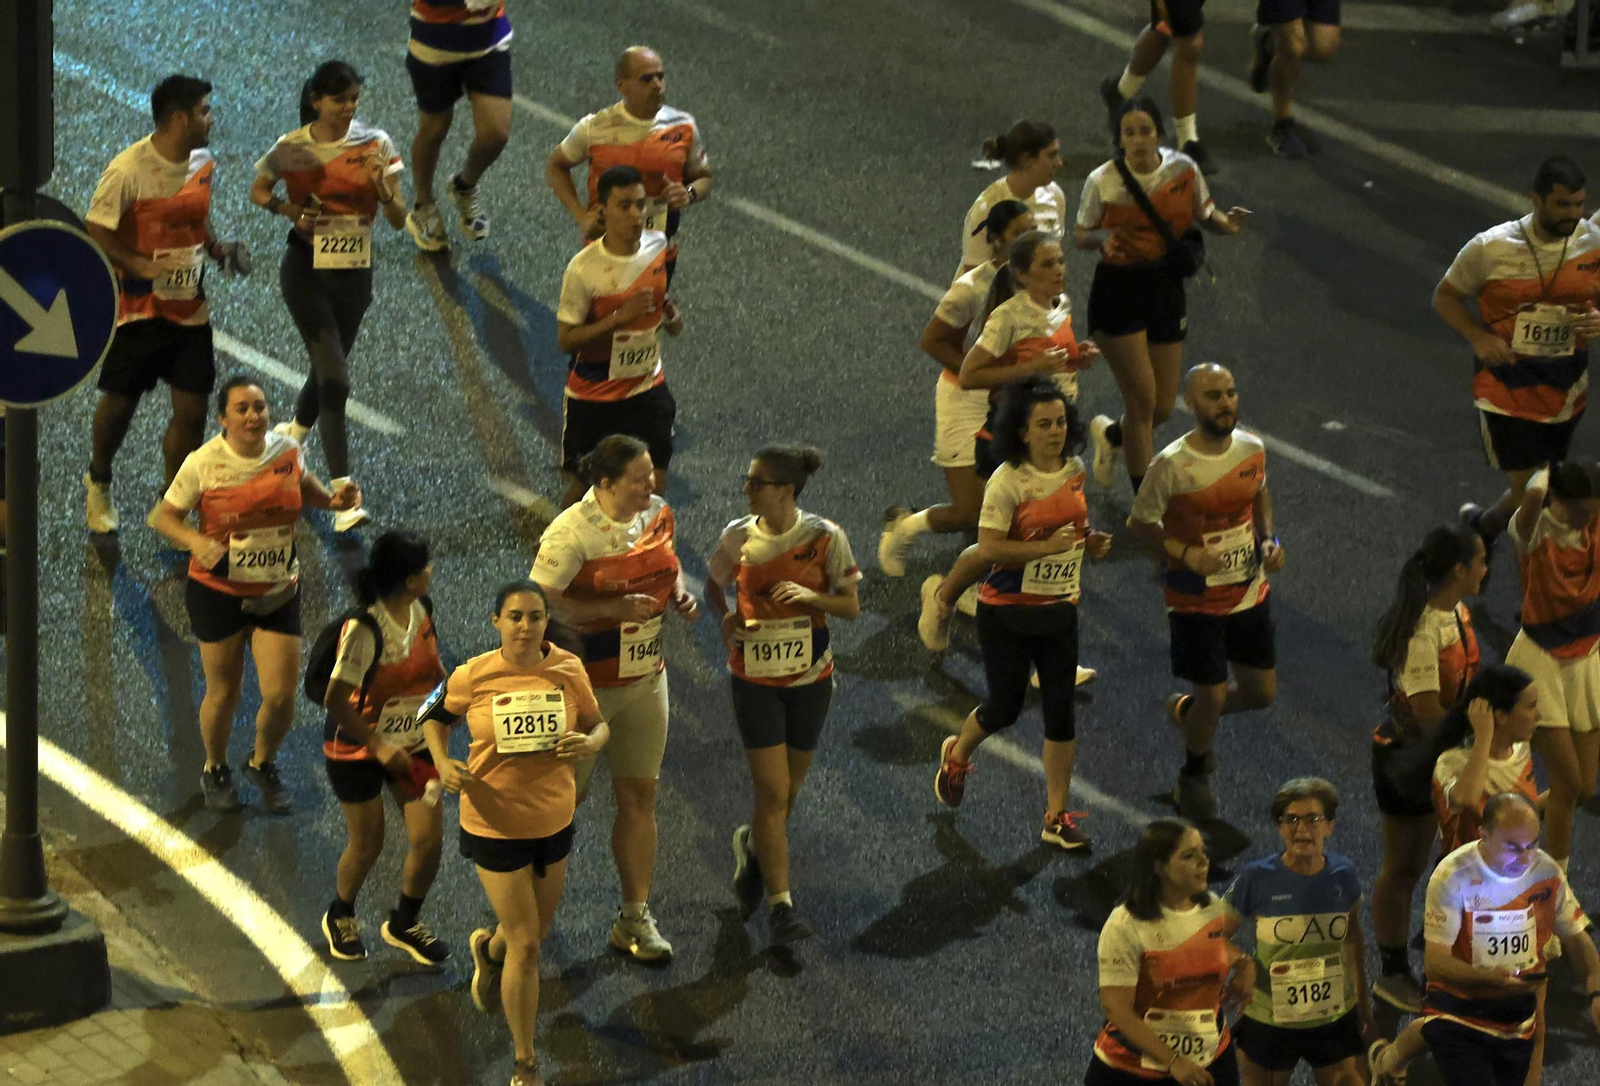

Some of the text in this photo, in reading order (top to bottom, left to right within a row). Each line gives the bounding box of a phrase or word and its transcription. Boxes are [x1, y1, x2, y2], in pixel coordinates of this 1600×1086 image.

[319, 236, 363, 253] 22221
[1522, 323, 1570, 342] 16118
[235, 549, 286, 568] 22094
[1033, 561, 1077, 580] 13742
[751, 640, 804, 662] 19172
[502, 713, 558, 736] 12815
[1273, 915, 1349, 945] CAO
[1487, 933, 1530, 956] 3190
[1287, 981, 1332, 1006] 3182
